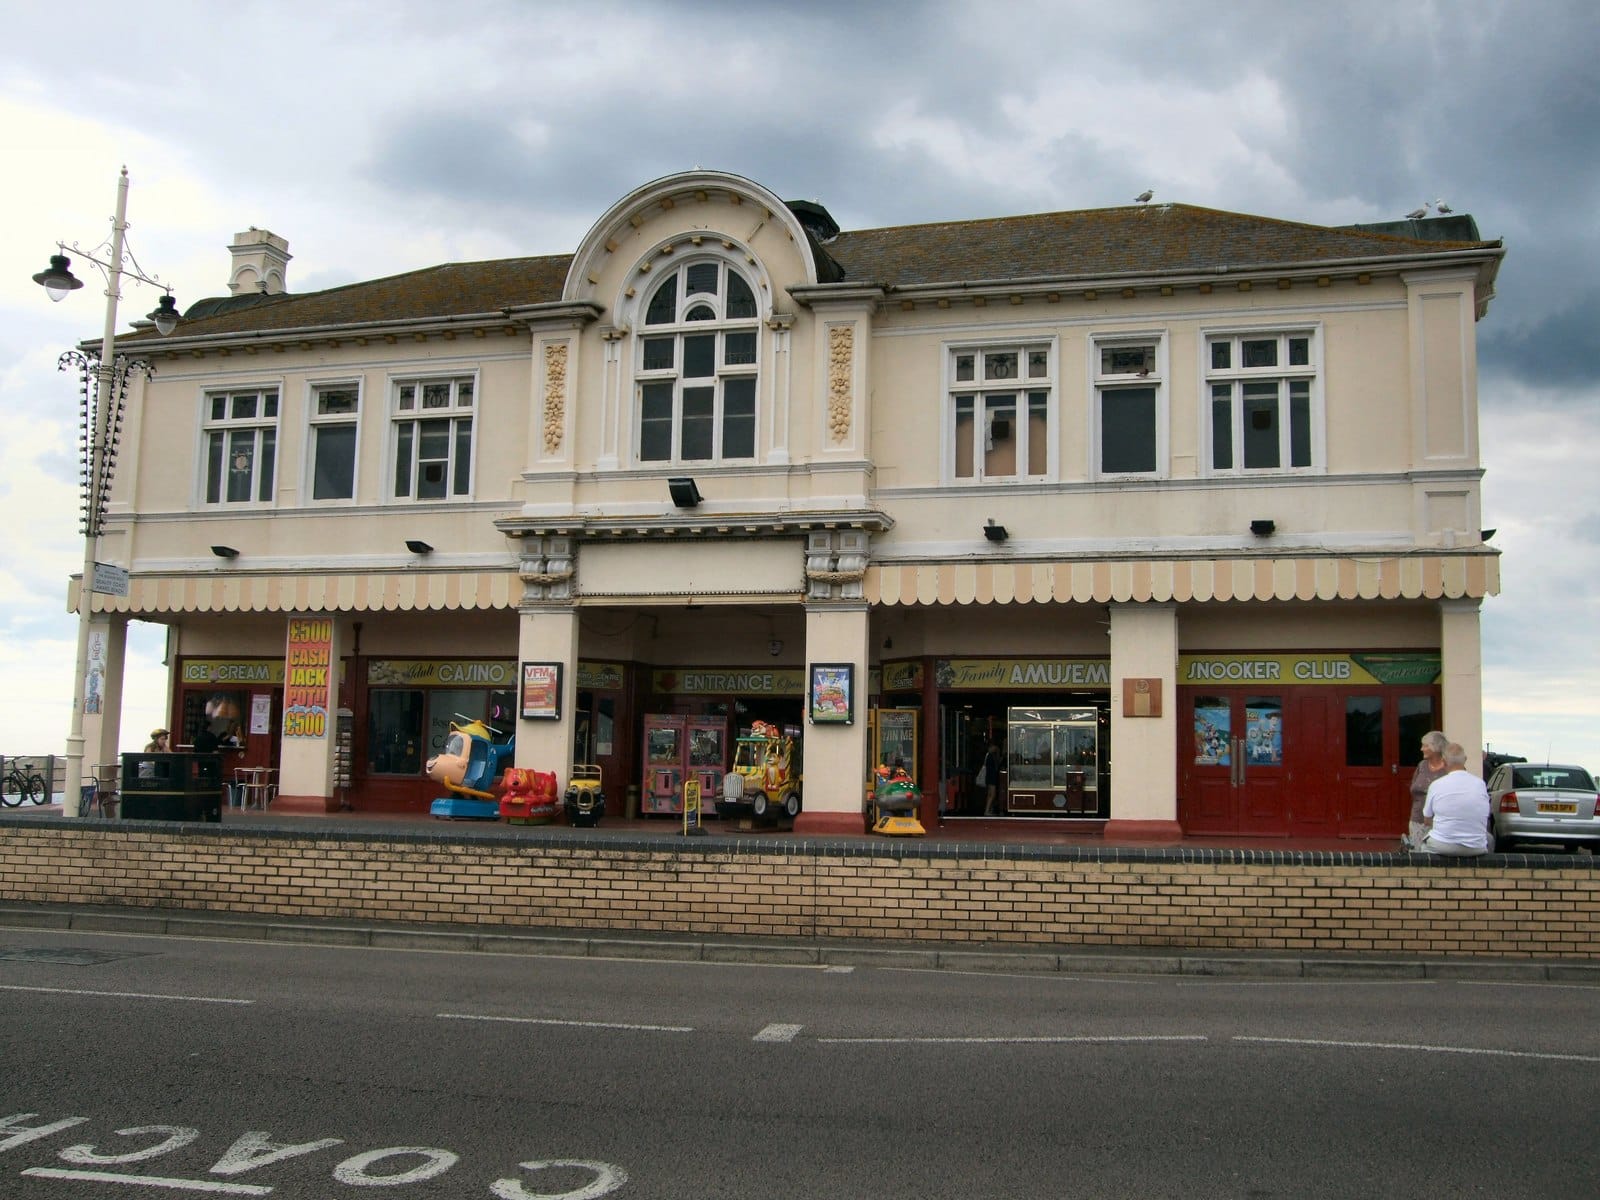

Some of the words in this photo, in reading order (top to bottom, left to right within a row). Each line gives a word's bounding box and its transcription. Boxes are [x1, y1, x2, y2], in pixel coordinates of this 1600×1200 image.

[289, 620, 331, 643] £500
[289, 648, 329, 667] CASH
[185, 664, 209, 679] ICE
[217, 664, 270, 680] CREAM
[289, 668, 326, 687] JACK
[439, 664, 505, 682] CASINO
[526, 667, 549, 678] VFM
[959, 663, 1006, 682] Family
[1010, 663, 1112, 684] AMUSEM
[1187, 660, 1281, 680] SNOOKER
[1294, 660, 1351, 679] CLUB
[684, 673, 773, 690] ENTRANCE
[288, 688, 327, 707] POT!!
[284, 711, 325, 737] £500
